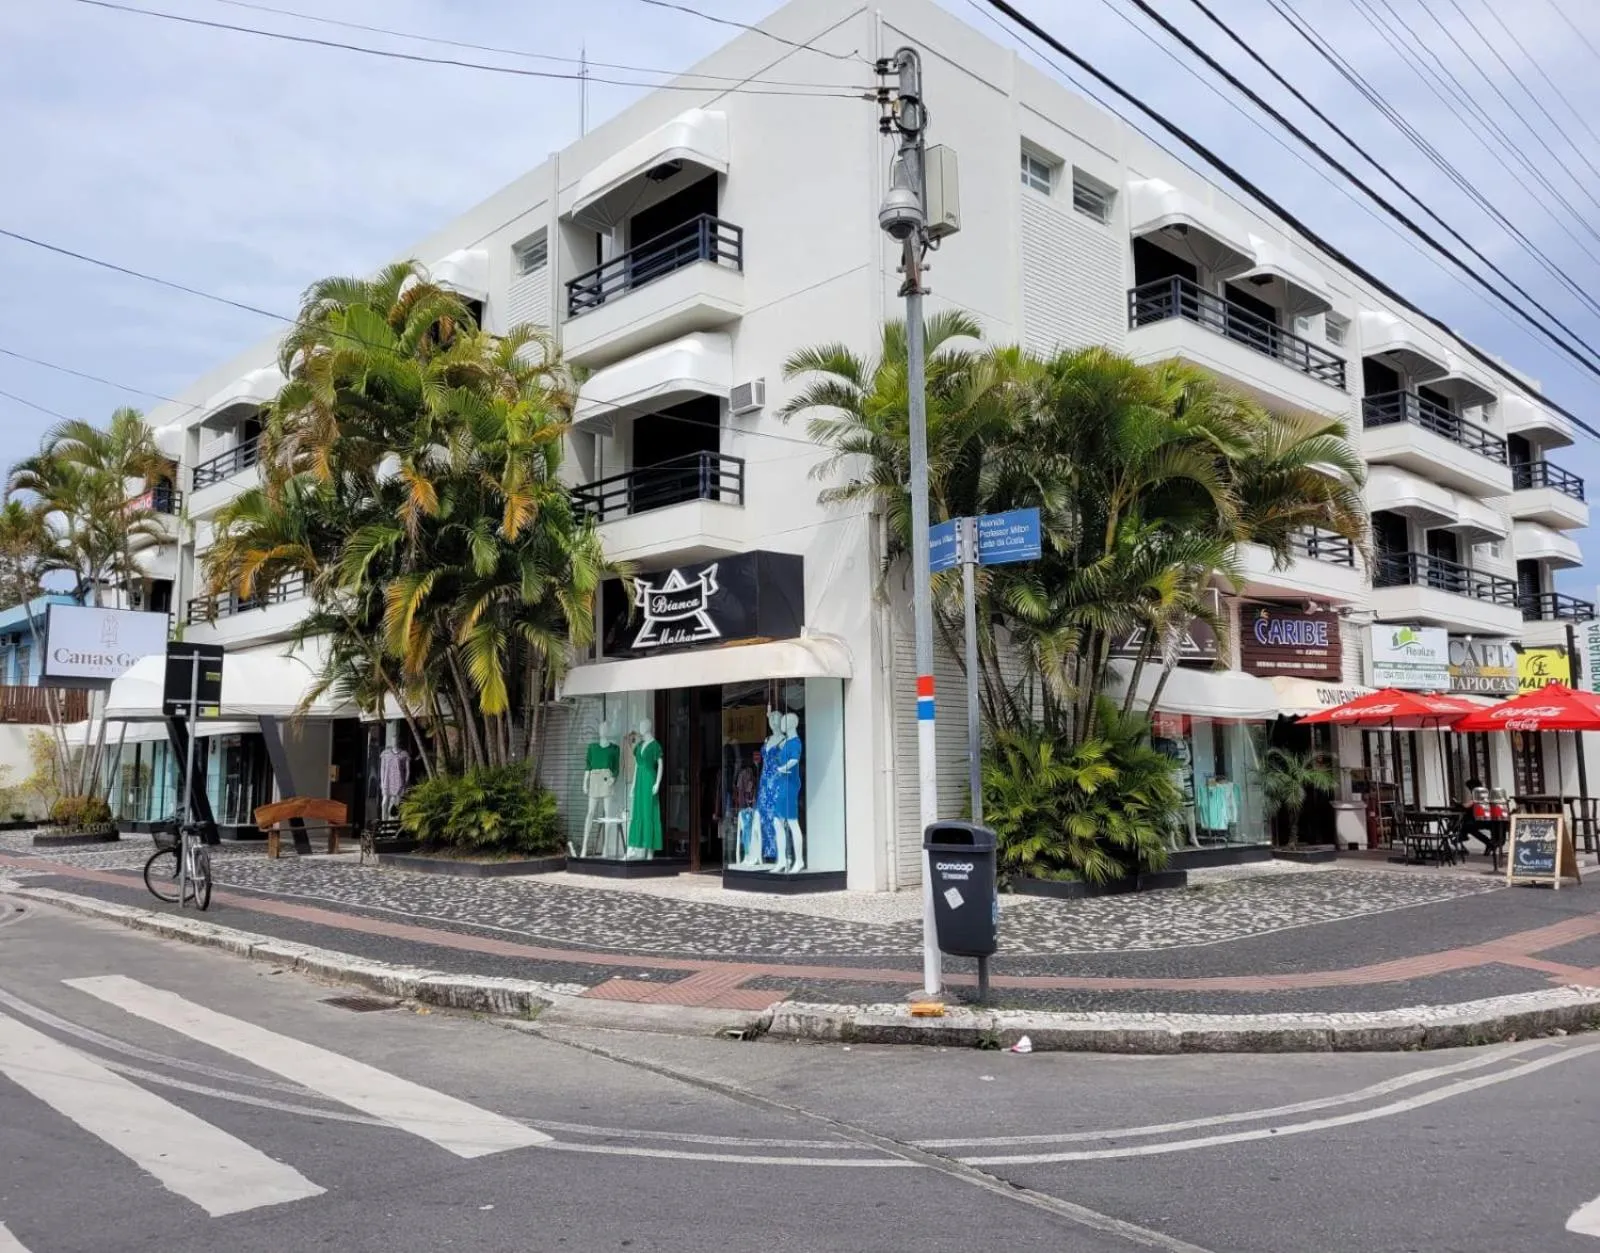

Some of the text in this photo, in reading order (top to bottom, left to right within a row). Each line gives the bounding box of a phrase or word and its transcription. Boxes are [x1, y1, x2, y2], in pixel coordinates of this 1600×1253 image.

[652, 595, 700, 613] Bianca
[1254, 618, 1329, 646] CARIBE
[54, 648, 113, 665] Canas
[1405, 646, 1436, 657] Realize
[1449, 677, 1517, 691] TAPIOCAS
